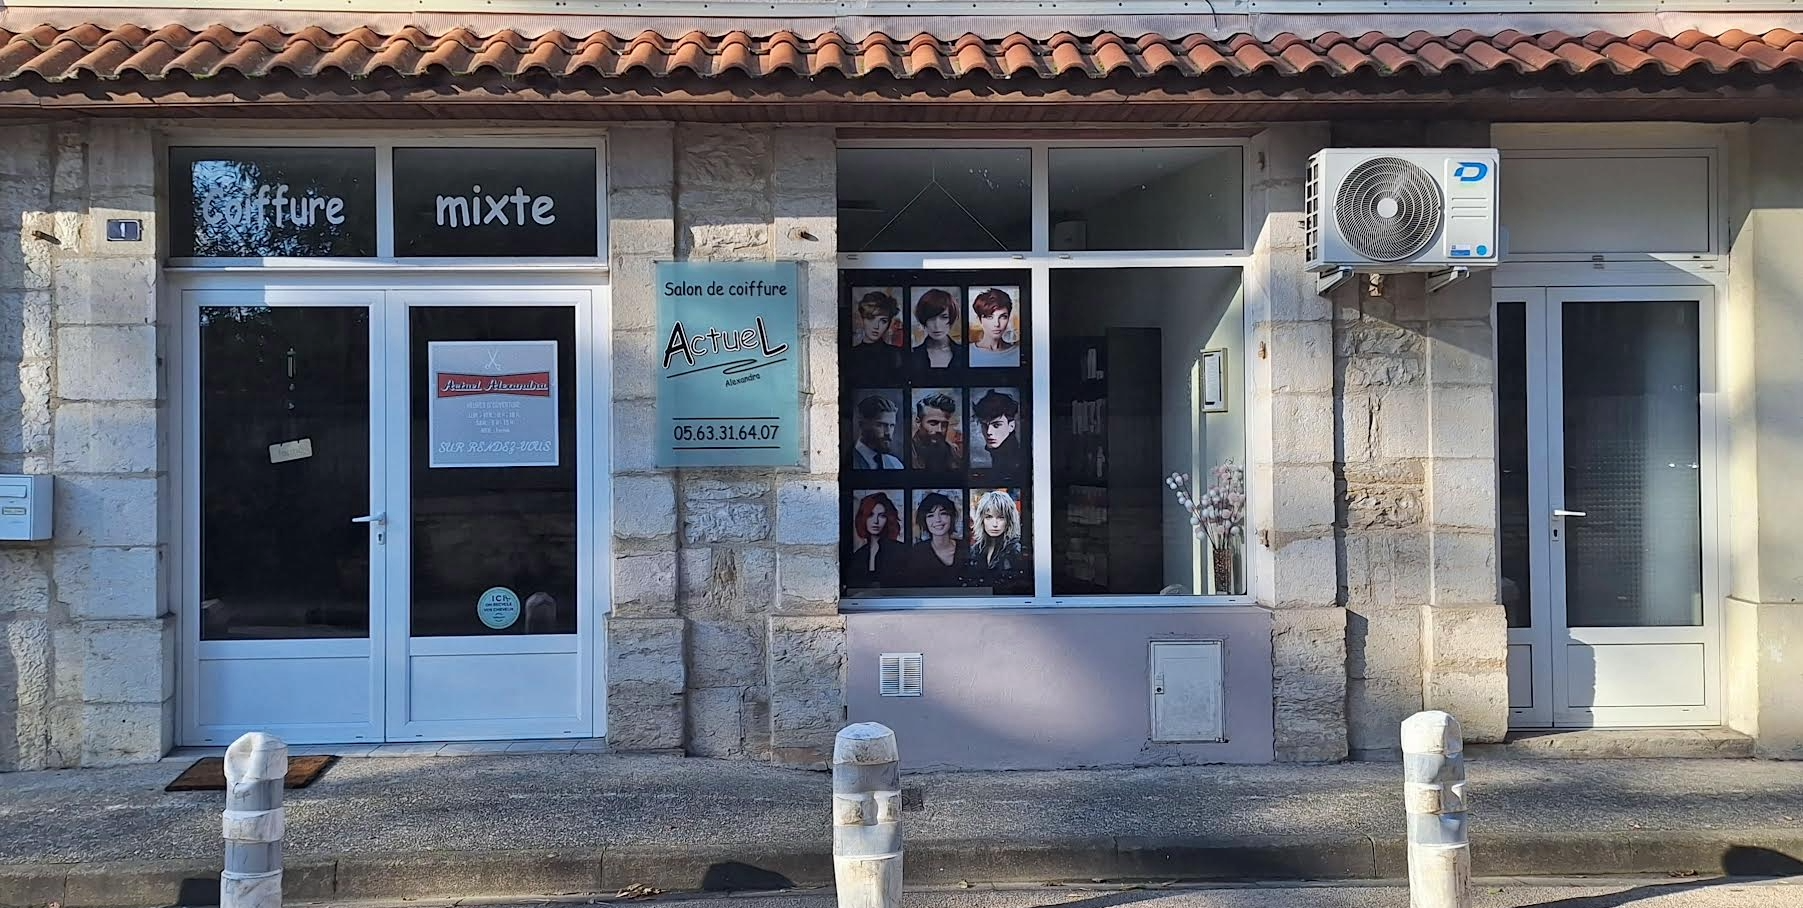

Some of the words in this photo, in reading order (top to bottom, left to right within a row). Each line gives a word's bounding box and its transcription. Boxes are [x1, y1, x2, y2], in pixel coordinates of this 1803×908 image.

[202, 184, 346, 228] Coiffure
[435, 184, 556, 229] mixte
[119, 222, 126, 238] 1
[664, 280, 703, 297] Salon
[707, 280, 725, 296] de
[729, 280, 788, 296] coiffure
[483, 379, 549, 392] Alexandra
[724, 371, 761, 388] Alexandra
[673, 424, 780, 442] 05.63.31.64.07
[438, 440, 465, 453] SUR
[467, 440, 552, 455] RENDEZ-VOUS
